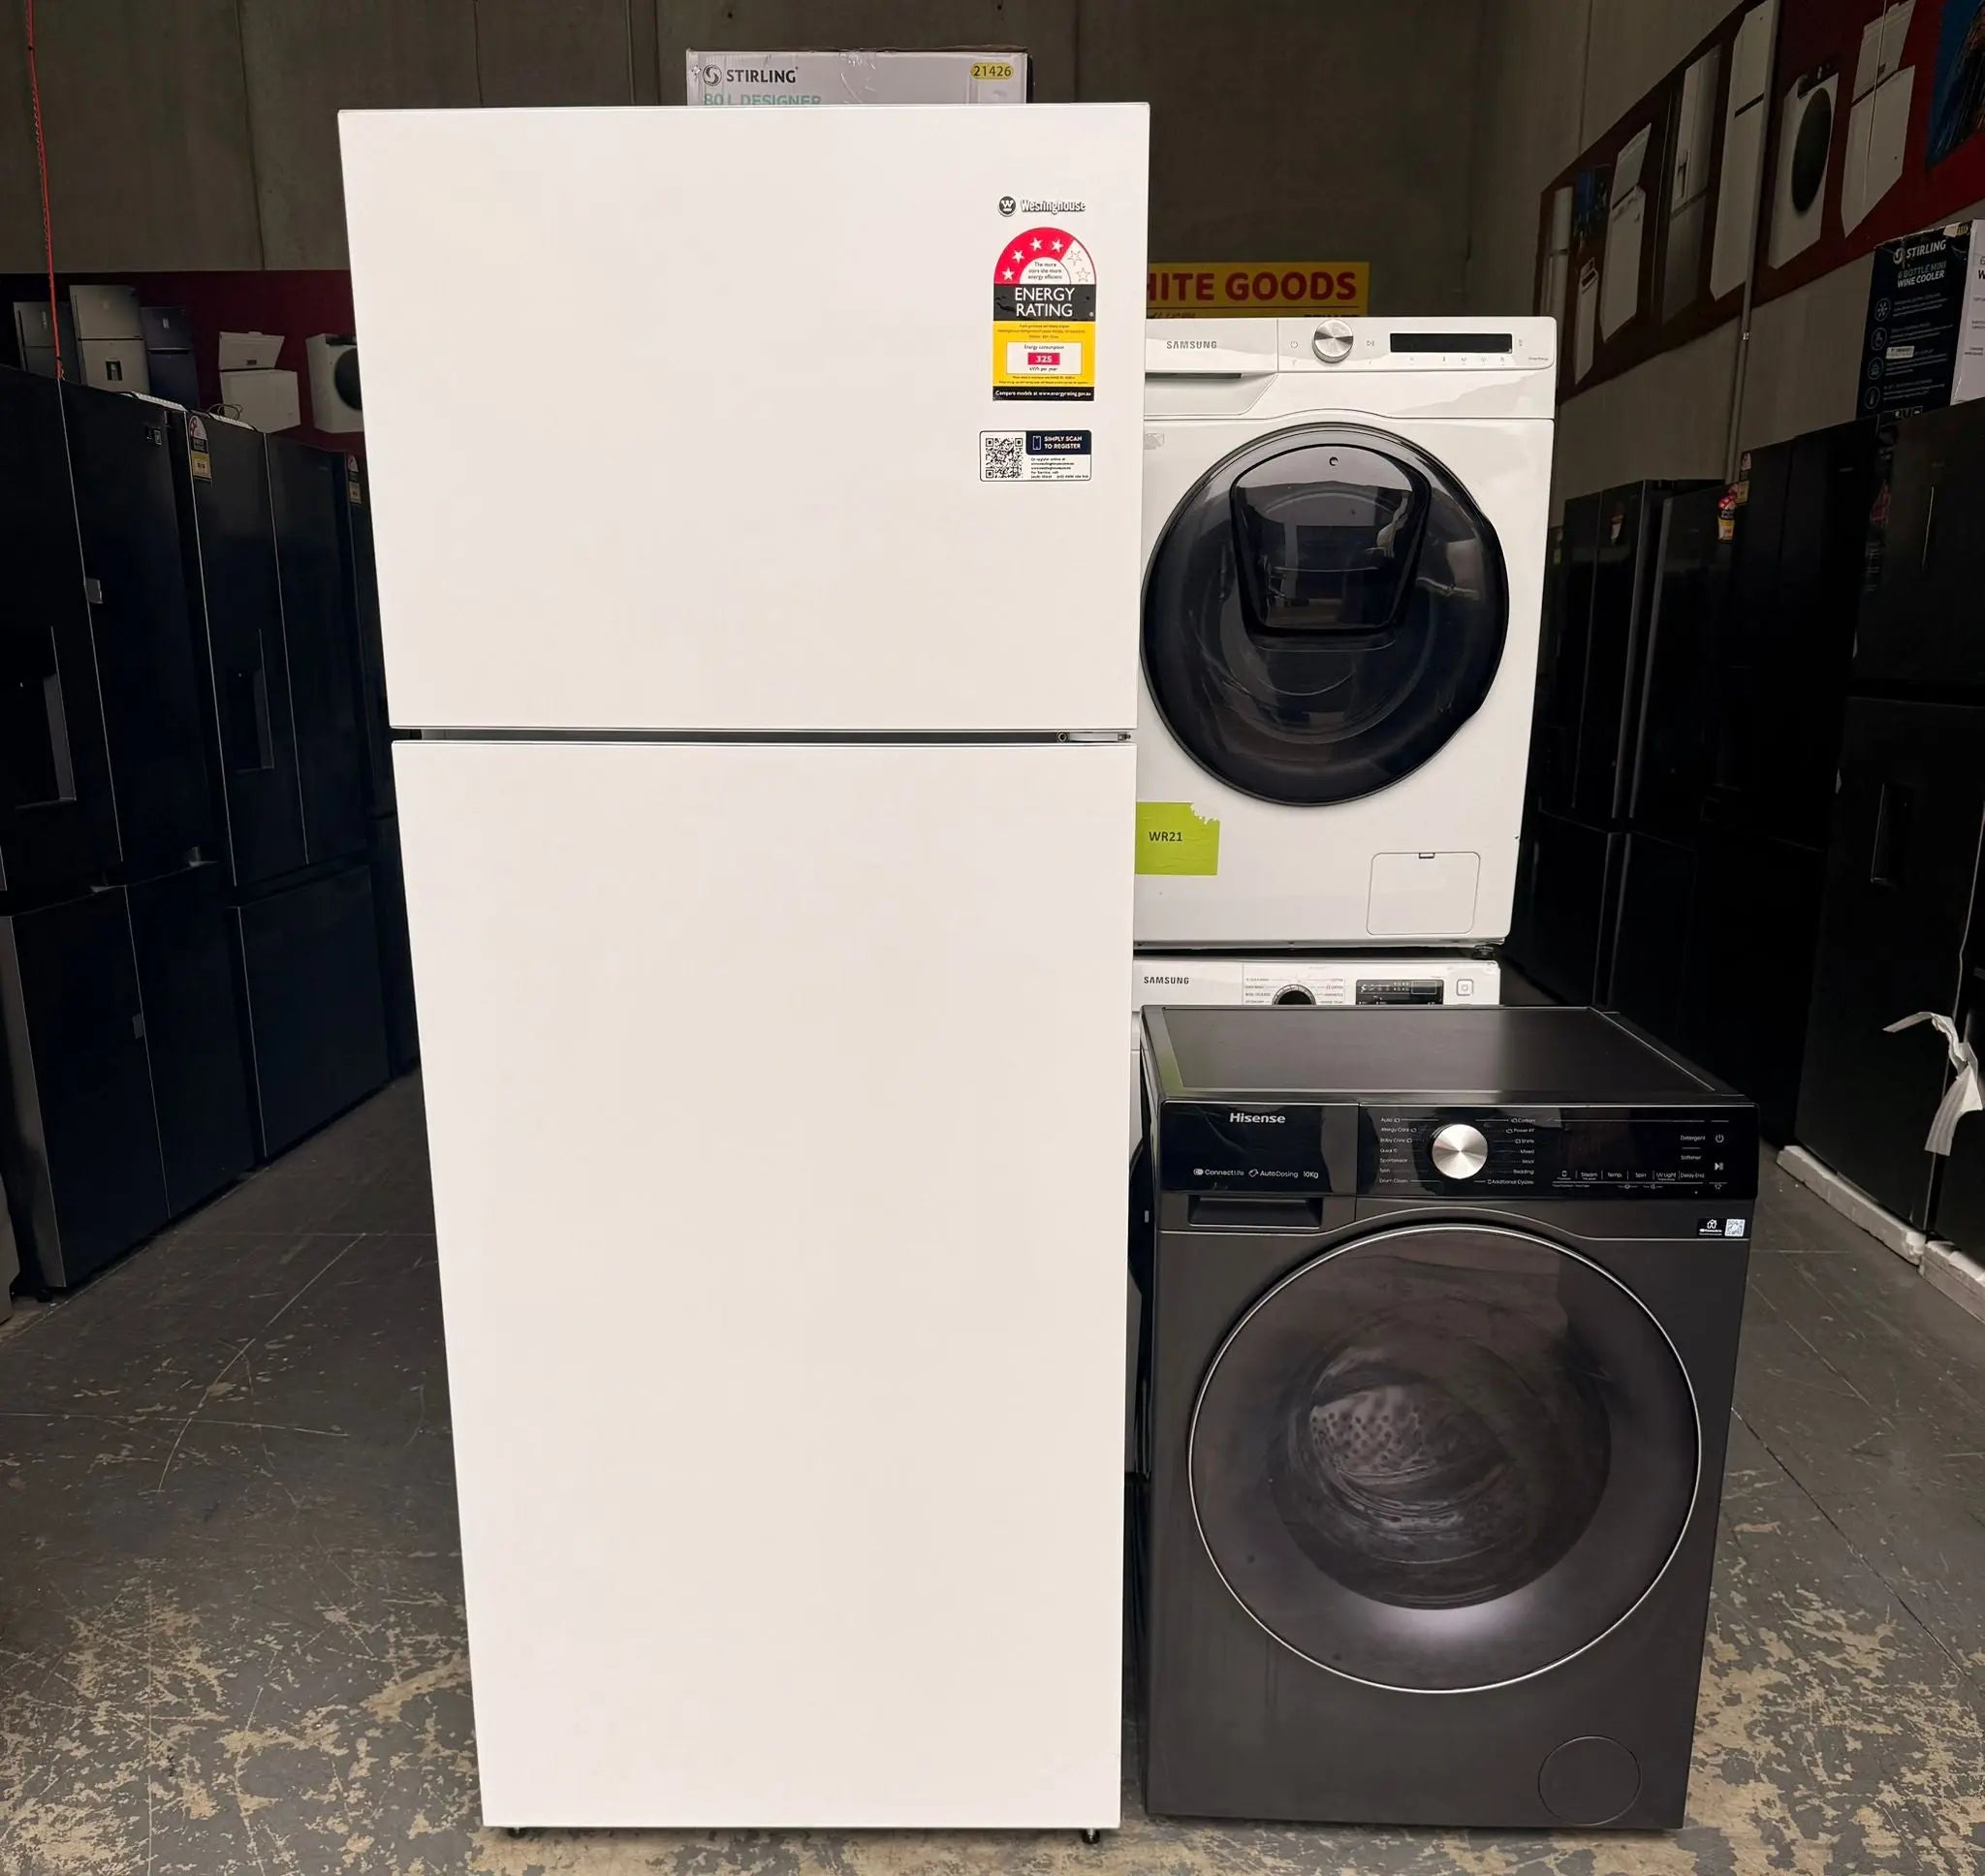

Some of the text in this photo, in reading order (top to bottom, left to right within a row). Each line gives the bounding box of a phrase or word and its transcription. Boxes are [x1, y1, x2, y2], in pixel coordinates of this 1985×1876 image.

[726, 69, 796, 83] STIRLING
[972, 65, 1012, 78] 21426
[740, 94, 822, 106] DESIGNER
[1021, 199, 1086, 215] Westinghouse
[1906, 239, 1947, 259] STIRLING
[1903, 264, 1930, 278] BOTTLE
[1930, 261, 1947, 271] MINI
[1225, 271, 1357, 301] GOODS
[1897, 270, 1945, 289] WINE COOLER
[1015, 288, 1075, 301] ENERGY
[1016, 303, 1073, 317] RATING
[1166, 340, 1217, 349] SAMSUNG
[1036, 355, 1053, 363] 325
[1149, 831, 1182, 841] WR21
[1144, 976, 1189, 985] SAMSUNG
[1229, 1112, 1286, 1124] Hisense
[1259, 1170, 1299, 1179] AutoDosing
[1303, 1171, 1319, 1179] 10Kg
